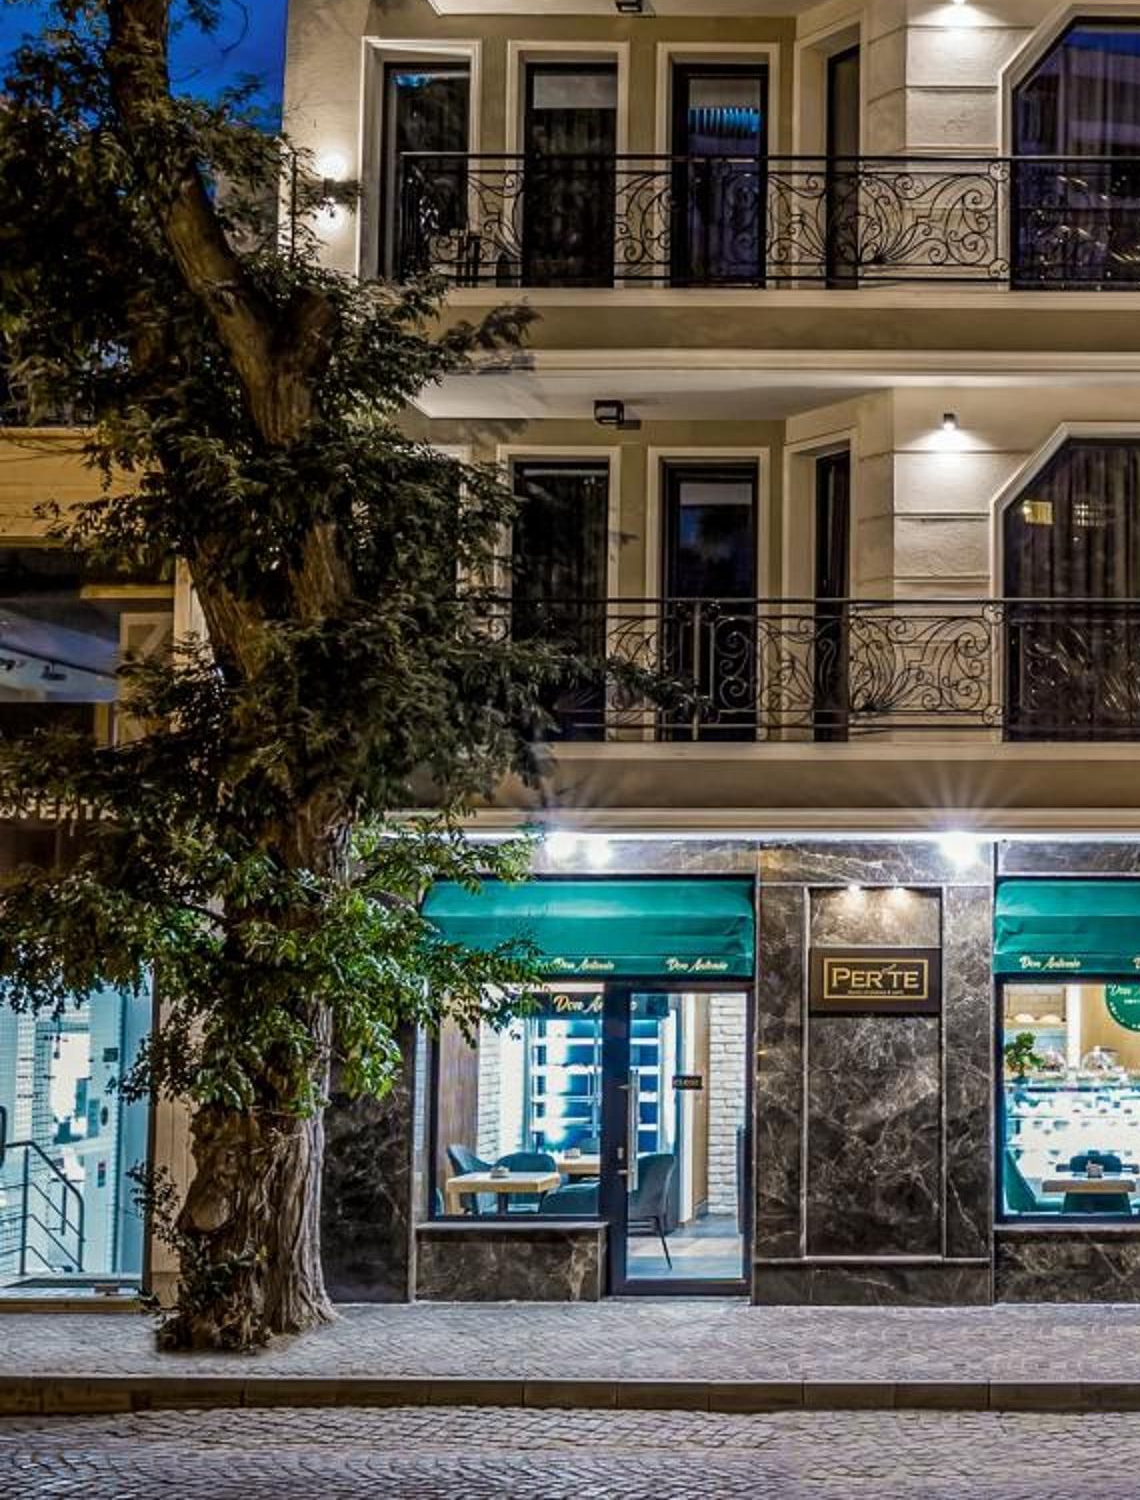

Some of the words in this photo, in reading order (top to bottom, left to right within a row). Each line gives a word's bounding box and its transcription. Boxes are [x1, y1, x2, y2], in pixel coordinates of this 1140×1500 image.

[665, 957, 689, 971] Don
[687, 957, 729, 973] Antonio
[1019, 955, 1041, 969] Don
[1041, 955, 1081, 971] Antonio
